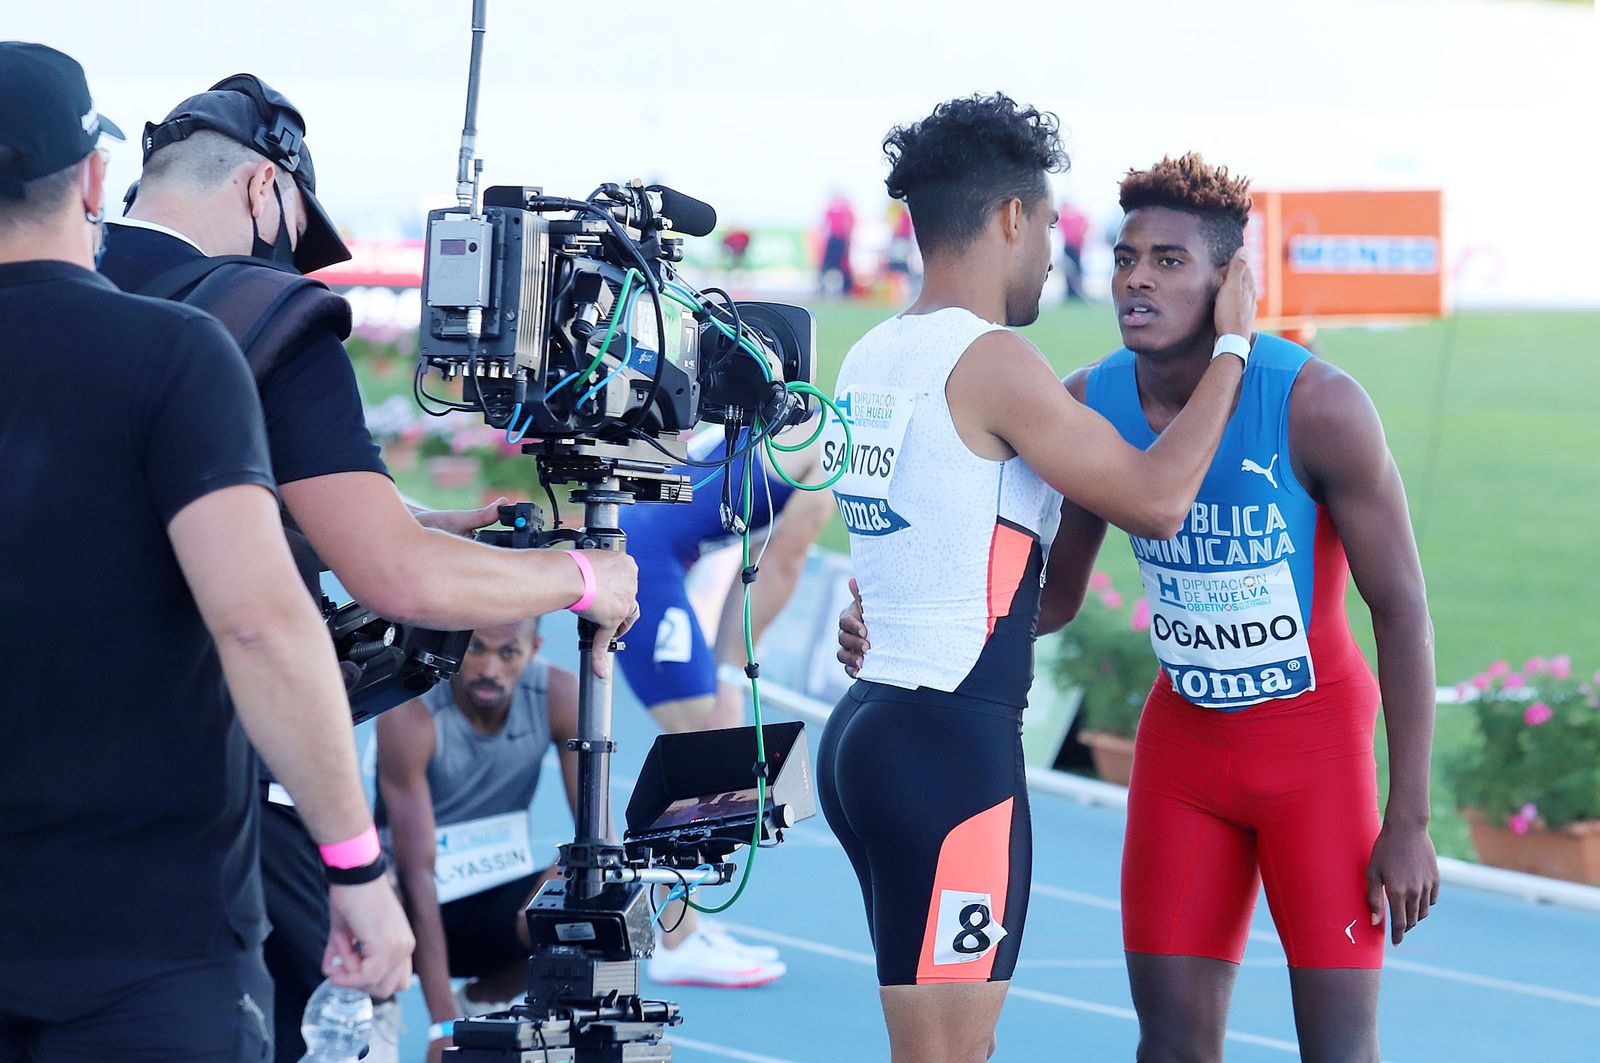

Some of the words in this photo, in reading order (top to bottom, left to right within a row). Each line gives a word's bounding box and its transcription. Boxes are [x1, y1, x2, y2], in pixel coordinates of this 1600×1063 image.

[822, 440, 895, 478] SANTOS
[1177, 502, 1287, 537] BLICA
[1129, 531, 1296, 567] OMINICANA
[1184, 591, 1201, 603] DE
[1186, 602, 1239, 612] OBJETIVOS
[1208, 585, 1269, 603] HUELVA
[656, 619, 676, 651] 2
[1153, 614, 1298, 650] OGANDO
[434, 848, 527, 885] L-YASSIN
[952, 903, 991, 954] 8
